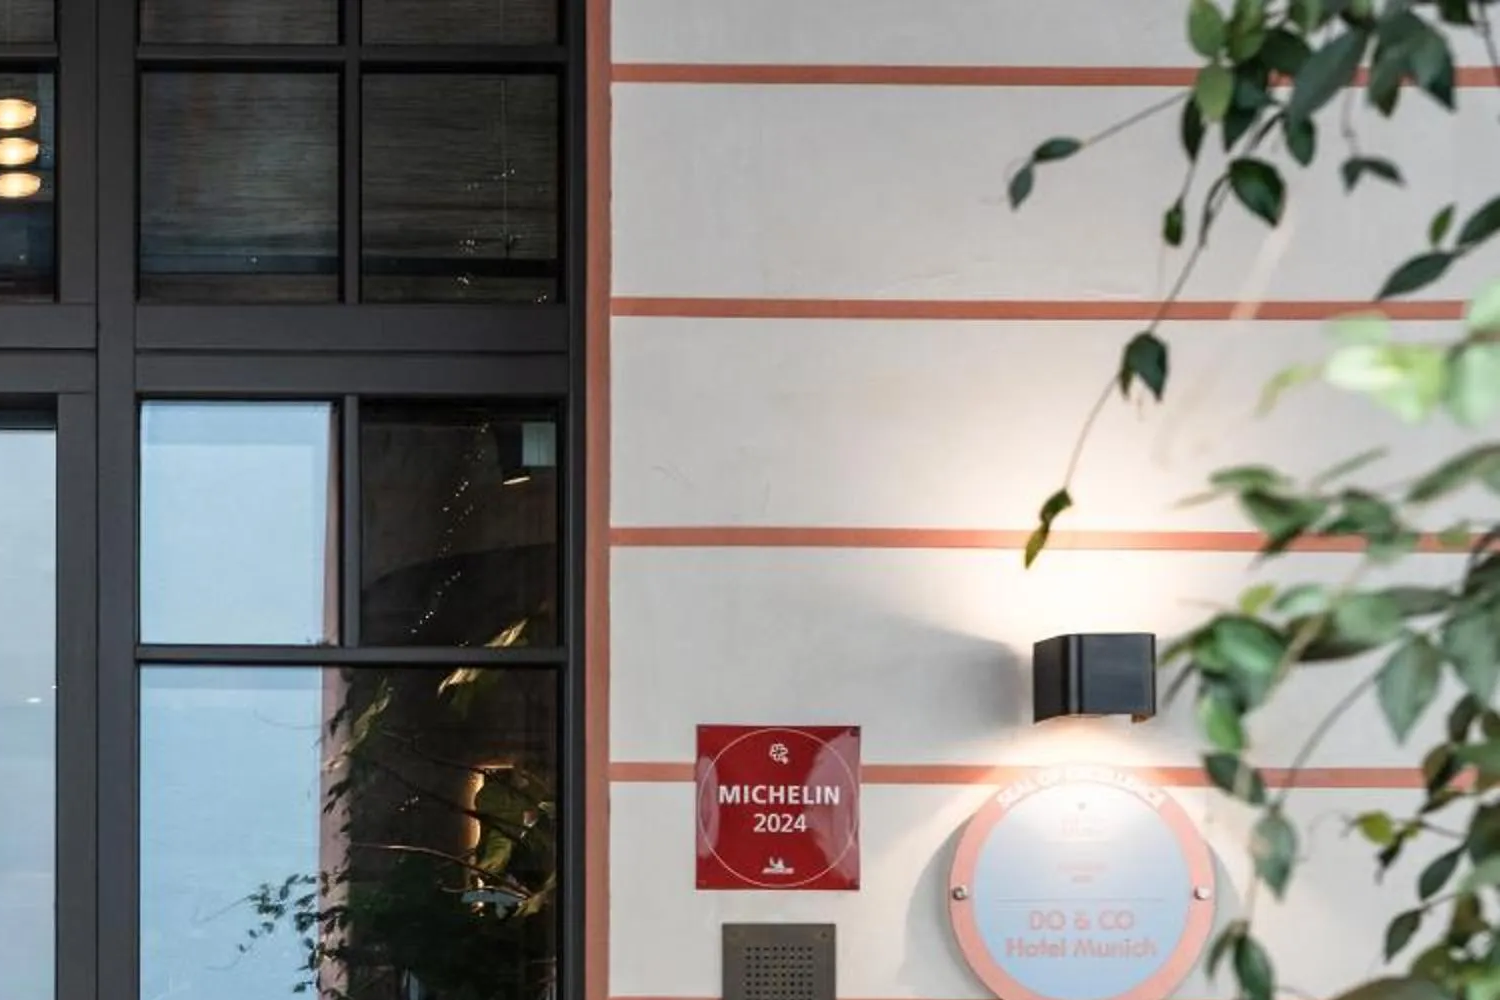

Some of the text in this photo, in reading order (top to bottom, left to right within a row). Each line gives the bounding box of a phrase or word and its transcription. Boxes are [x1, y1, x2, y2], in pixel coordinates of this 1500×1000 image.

[718, 785, 841, 805] MICHELIN
[753, 814, 807, 833] 2024
[1029, 910, 1066, 931] DO
[1098, 910, 1135, 931] CO
[1006, 938, 1158, 958] Hotel Munich
